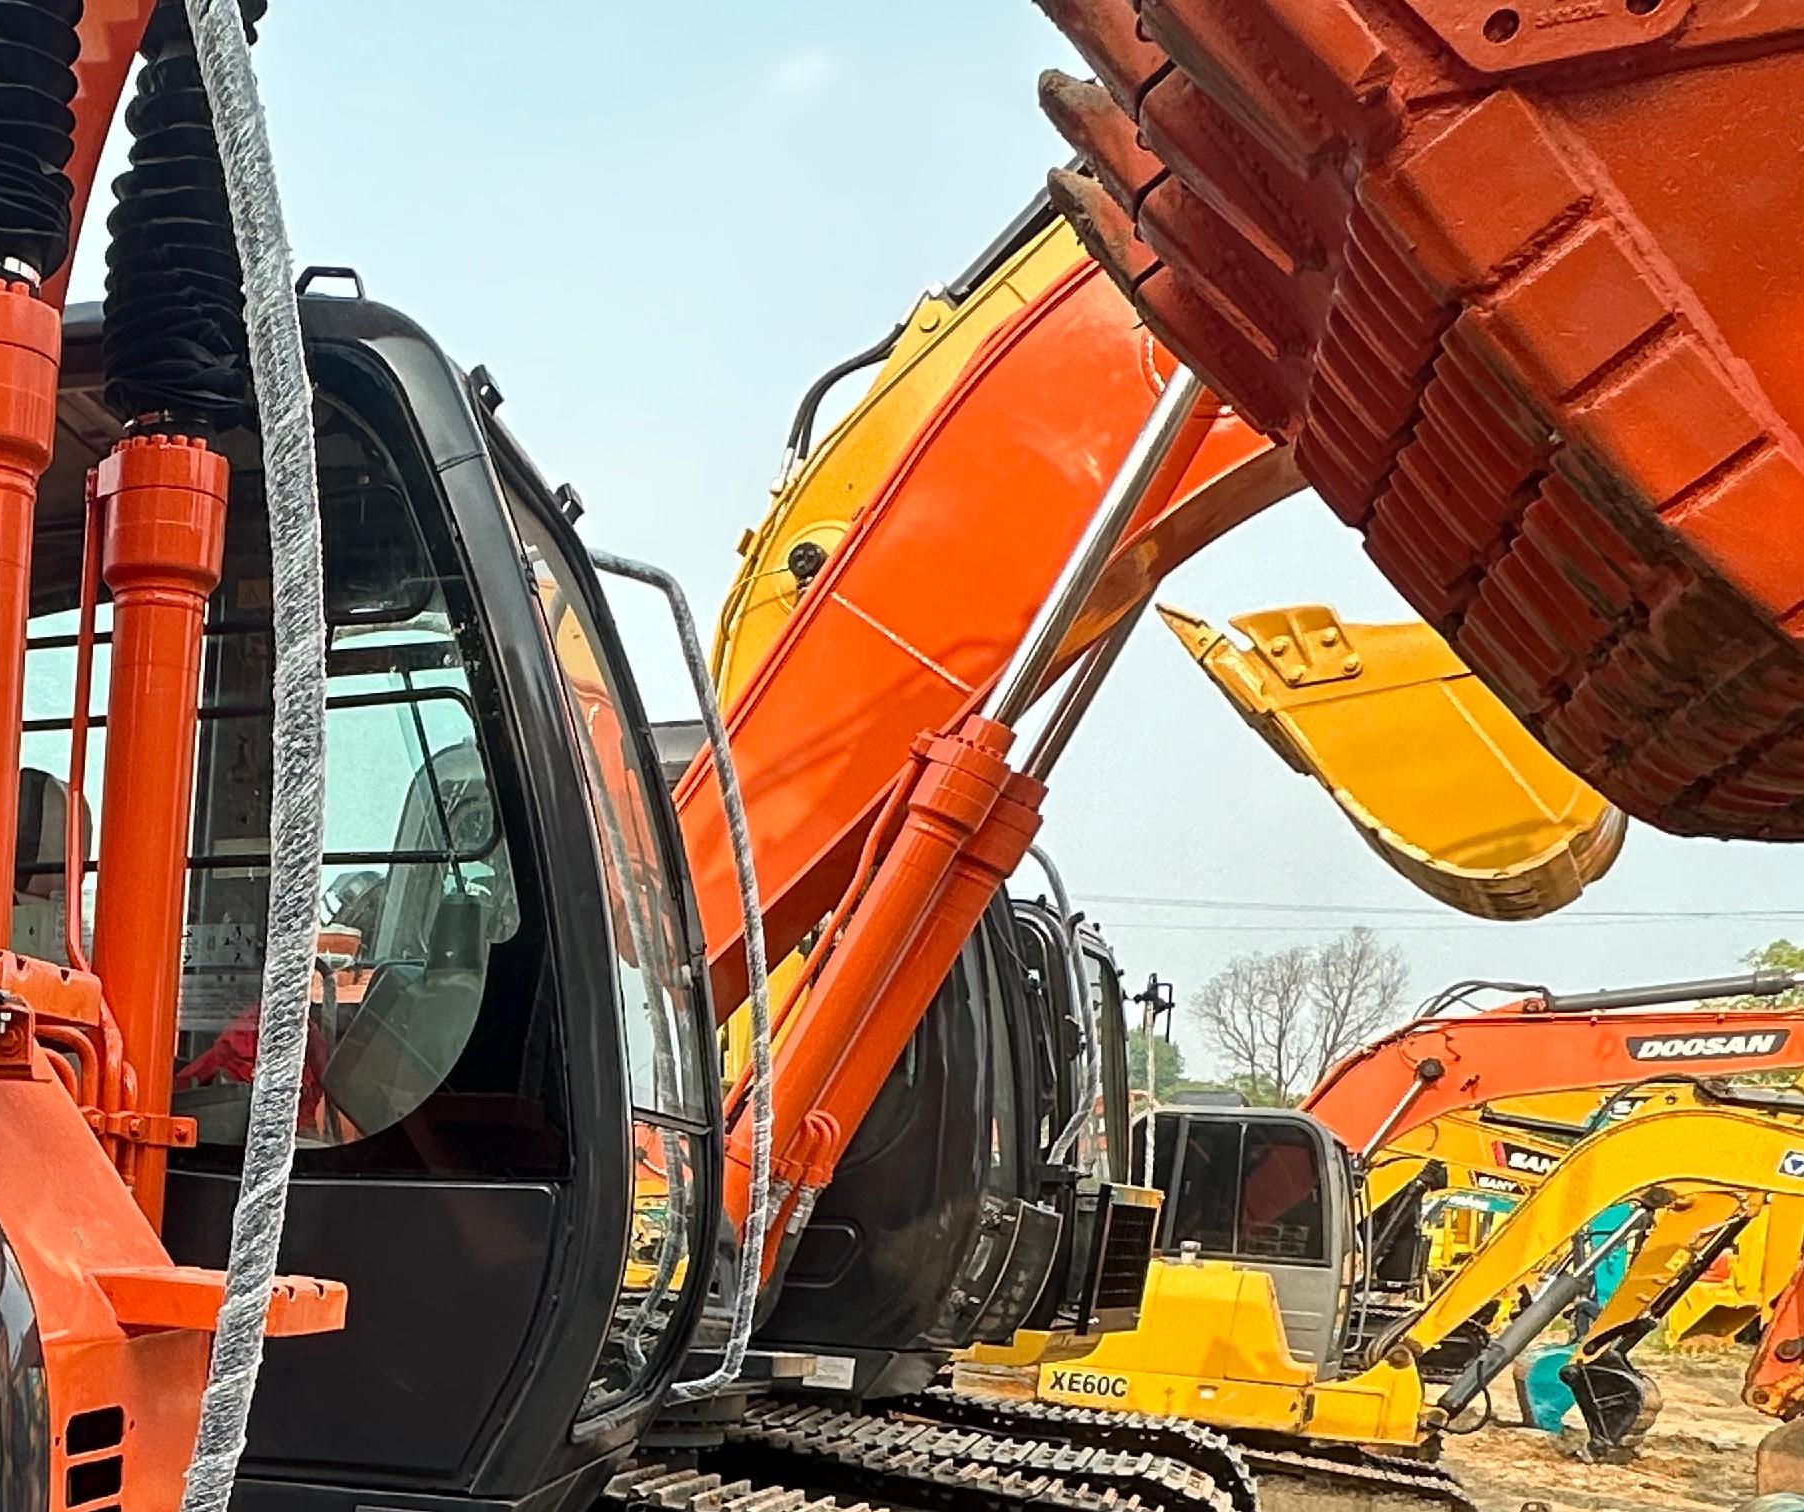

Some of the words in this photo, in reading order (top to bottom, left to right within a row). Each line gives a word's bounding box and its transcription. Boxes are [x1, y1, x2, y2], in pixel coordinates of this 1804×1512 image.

[1637, 1034, 1776, 1059] DOOSAN
[1509, 1152, 1560, 1174] SAN
[1478, 1176, 1518, 1192] SANY
[1049, 1370, 1127, 1397] XE60C
